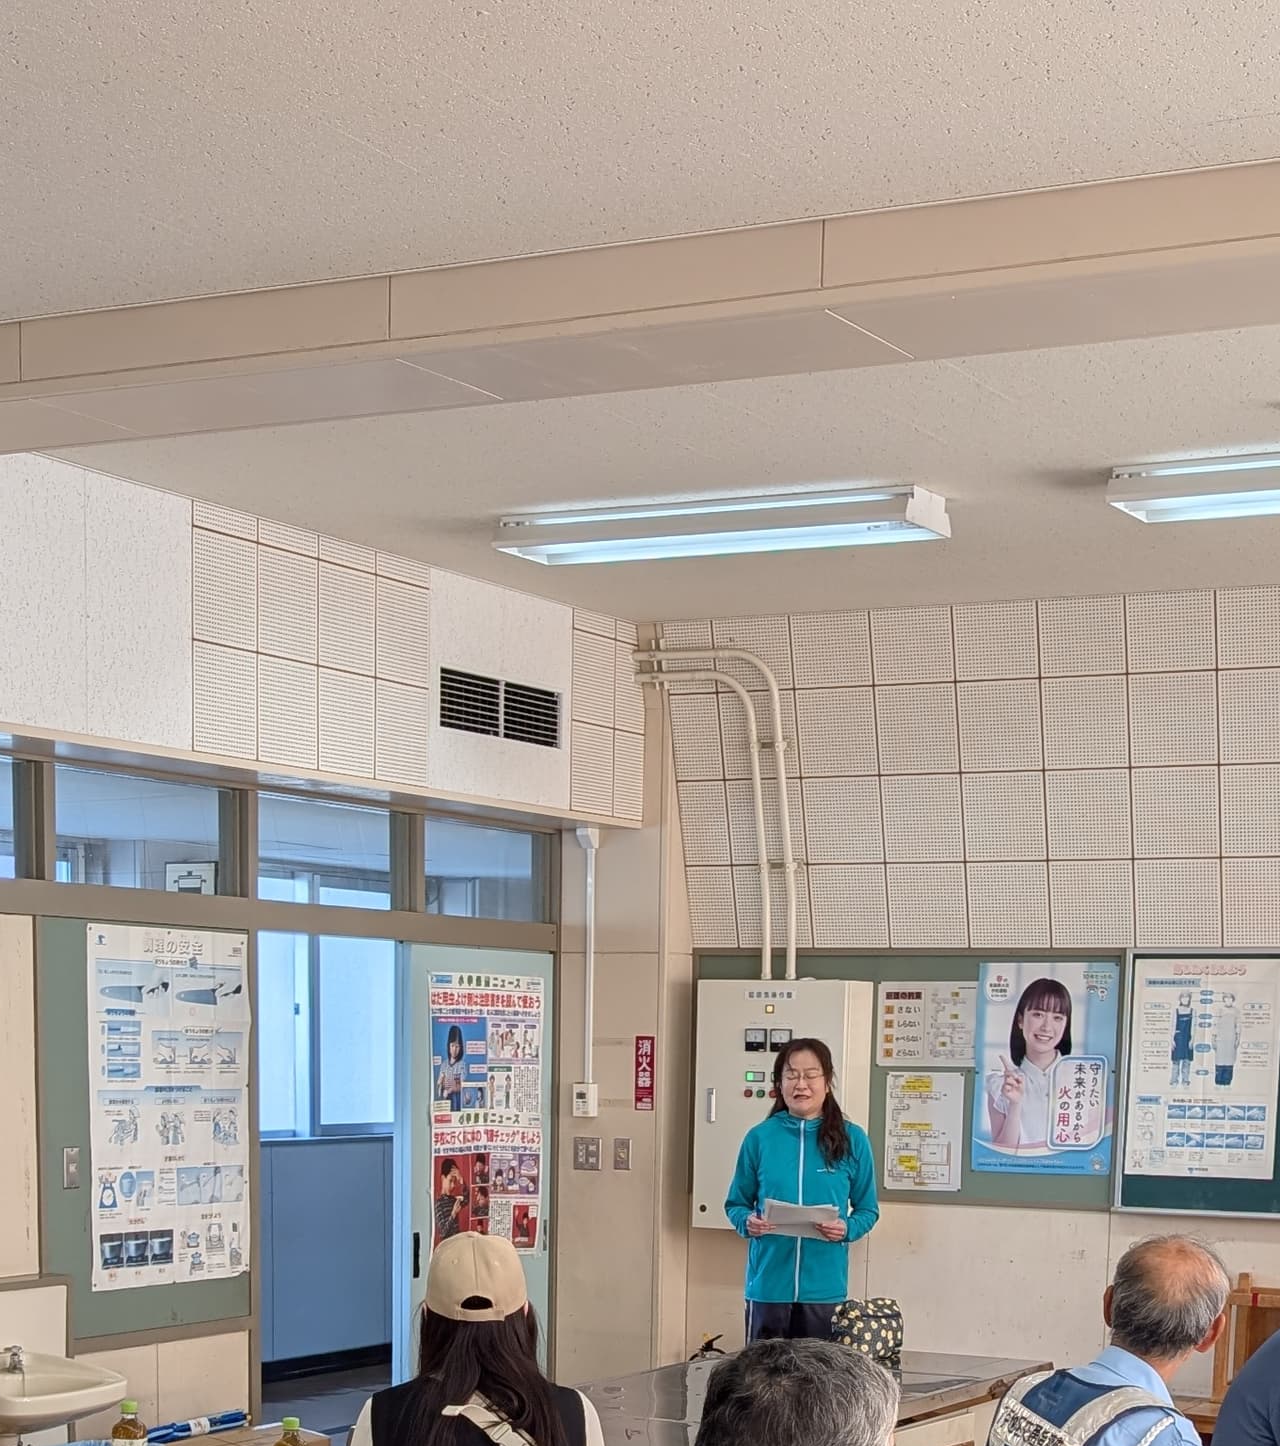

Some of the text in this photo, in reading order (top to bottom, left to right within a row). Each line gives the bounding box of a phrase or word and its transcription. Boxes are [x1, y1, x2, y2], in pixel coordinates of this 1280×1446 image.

[638, 1040, 652, 1087] 消火器
[1089, 1062, 1101, 1107] 守りたい
[1056, 1086, 1072, 1143] 火の用心
[1073, 1063, 1086, 1142] 未来があるから
